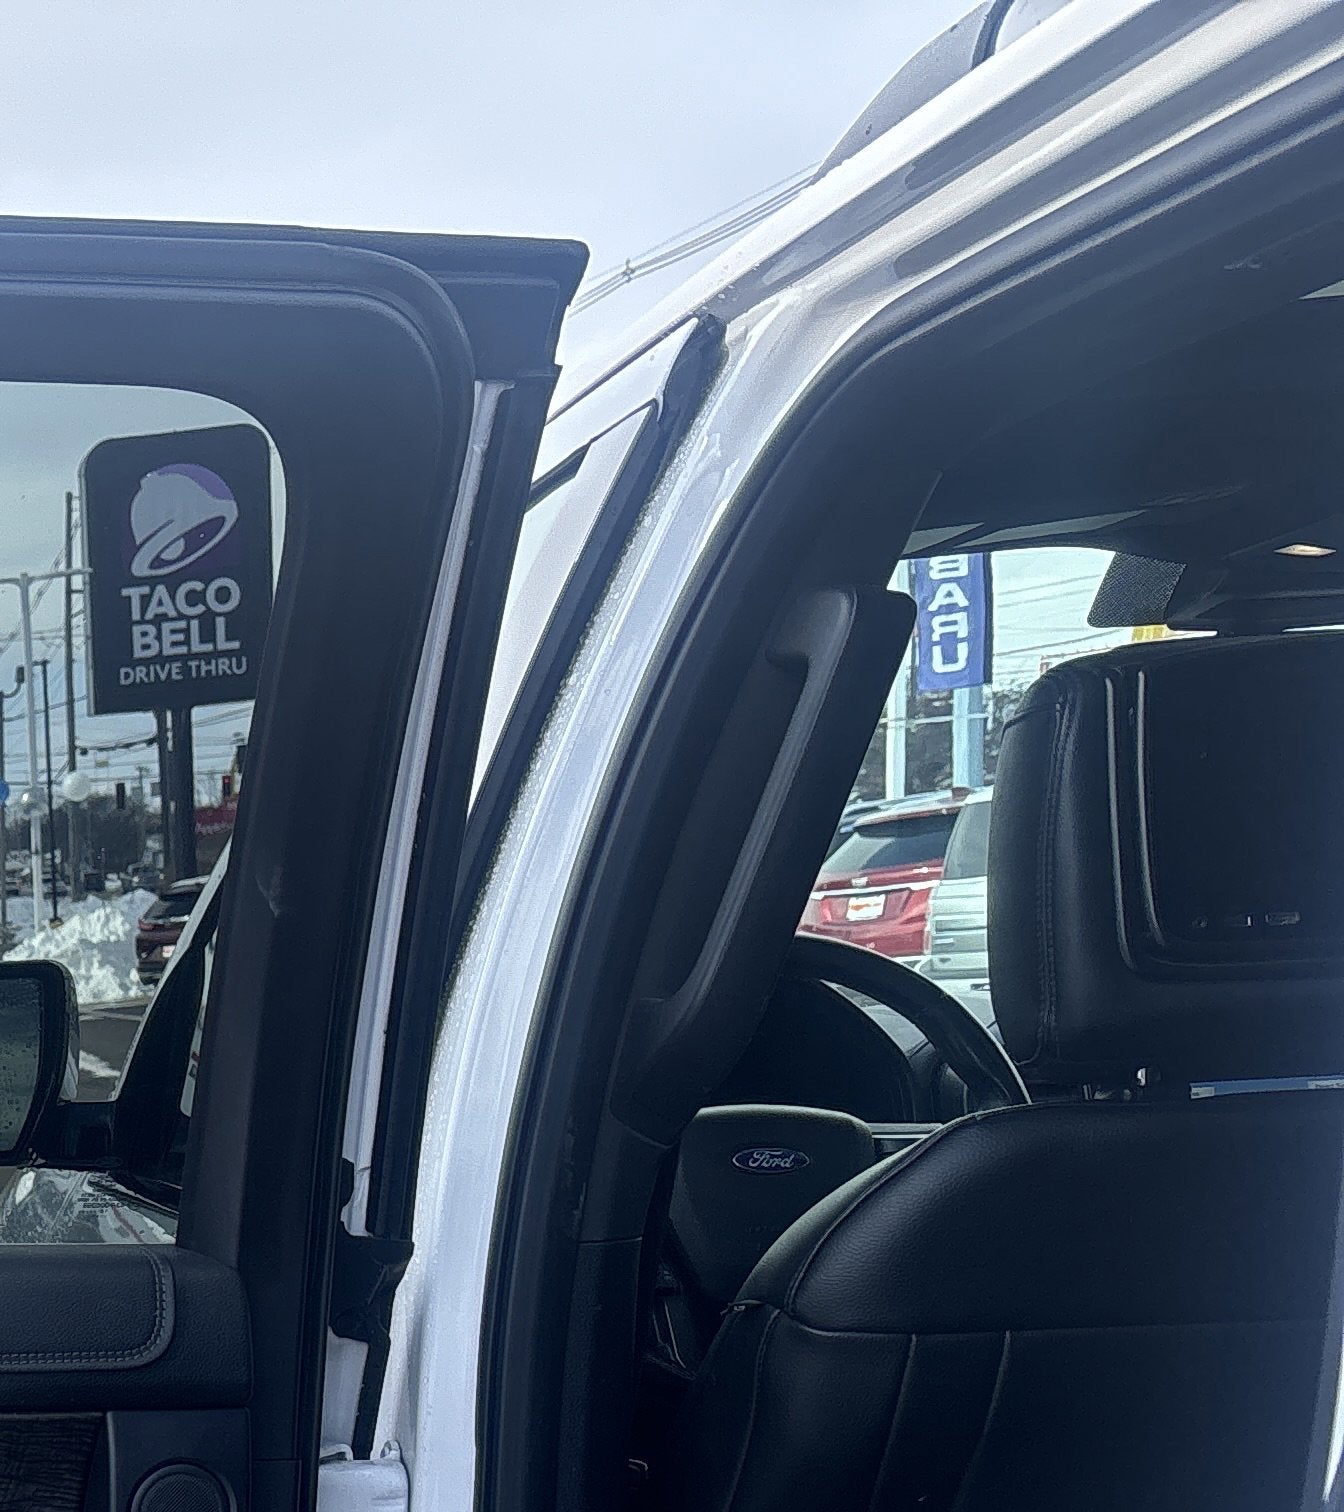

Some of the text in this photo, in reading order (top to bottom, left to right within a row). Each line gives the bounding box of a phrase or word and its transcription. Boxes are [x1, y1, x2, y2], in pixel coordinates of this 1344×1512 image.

[120, 576, 241, 622] TACO
[132, 616, 240, 659] BELL
[119, 656, 247, 685] DRIVE THRU
[748, 1150, 795, 1168] Ford
